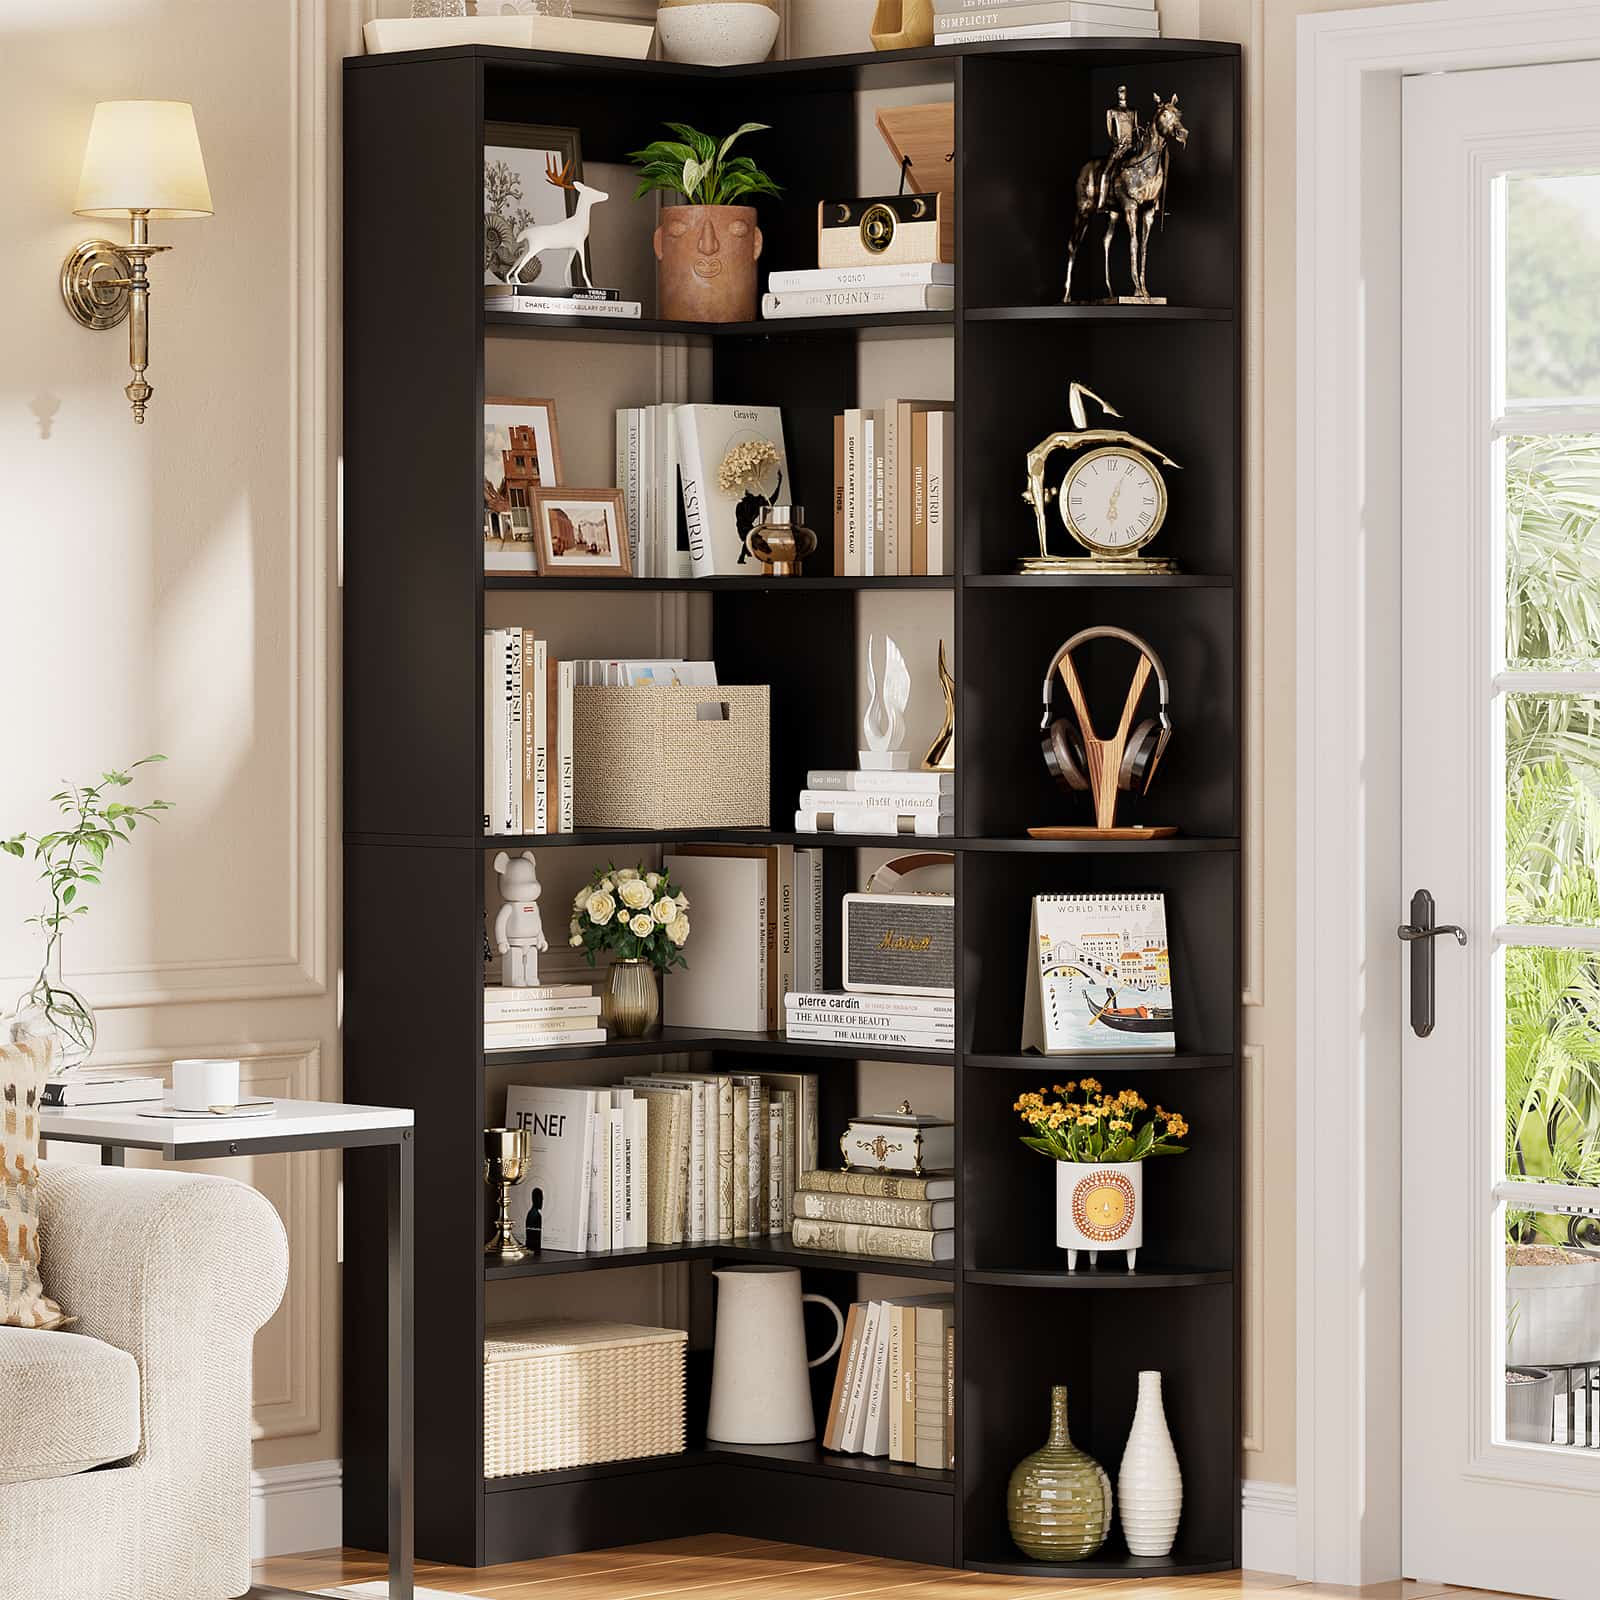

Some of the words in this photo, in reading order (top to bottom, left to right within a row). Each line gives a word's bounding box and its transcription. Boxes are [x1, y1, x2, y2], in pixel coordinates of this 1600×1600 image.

[940, 13, 999, 29] SIMPLICITY
[837, 272, 866, 283] LONDON
[524, 301, 550, 310] CHANEL
[825, 293, 870, 305] KINFOLK
[733, 409, 759, 422] Gravity
[915, 465, 923, 526] PHILADELPHIA
[537, 747, 545, 783] FISH
[563, 756, 571, 788] FISH
[537, 786, 545, 829] LOST
[563, 792, 571, 830] LOST
[760, 897, 766, 906] To
[1057, 905, 1093, 913] WORLD
[1098, 904, 1147, 912] TRAVELER
[814, 924, 821, 936] BY
[798, 995, 827, 1008] pierre
[829, 998, 860, 1009] cardin
[796, 1012, 813, 1022] THE
[814, 1013, 845, 1024] ALLURE
[845, 1015, 857, 1024] OF
[858, 1016, 891, 1026] BEAUTY
[833, 1030, 848, 1040] THE
[849, 1031, 877, 1041] ALLURE
[878, 1032, 888, 1041] OF
[889, 1033, 906, 1042] MEN
